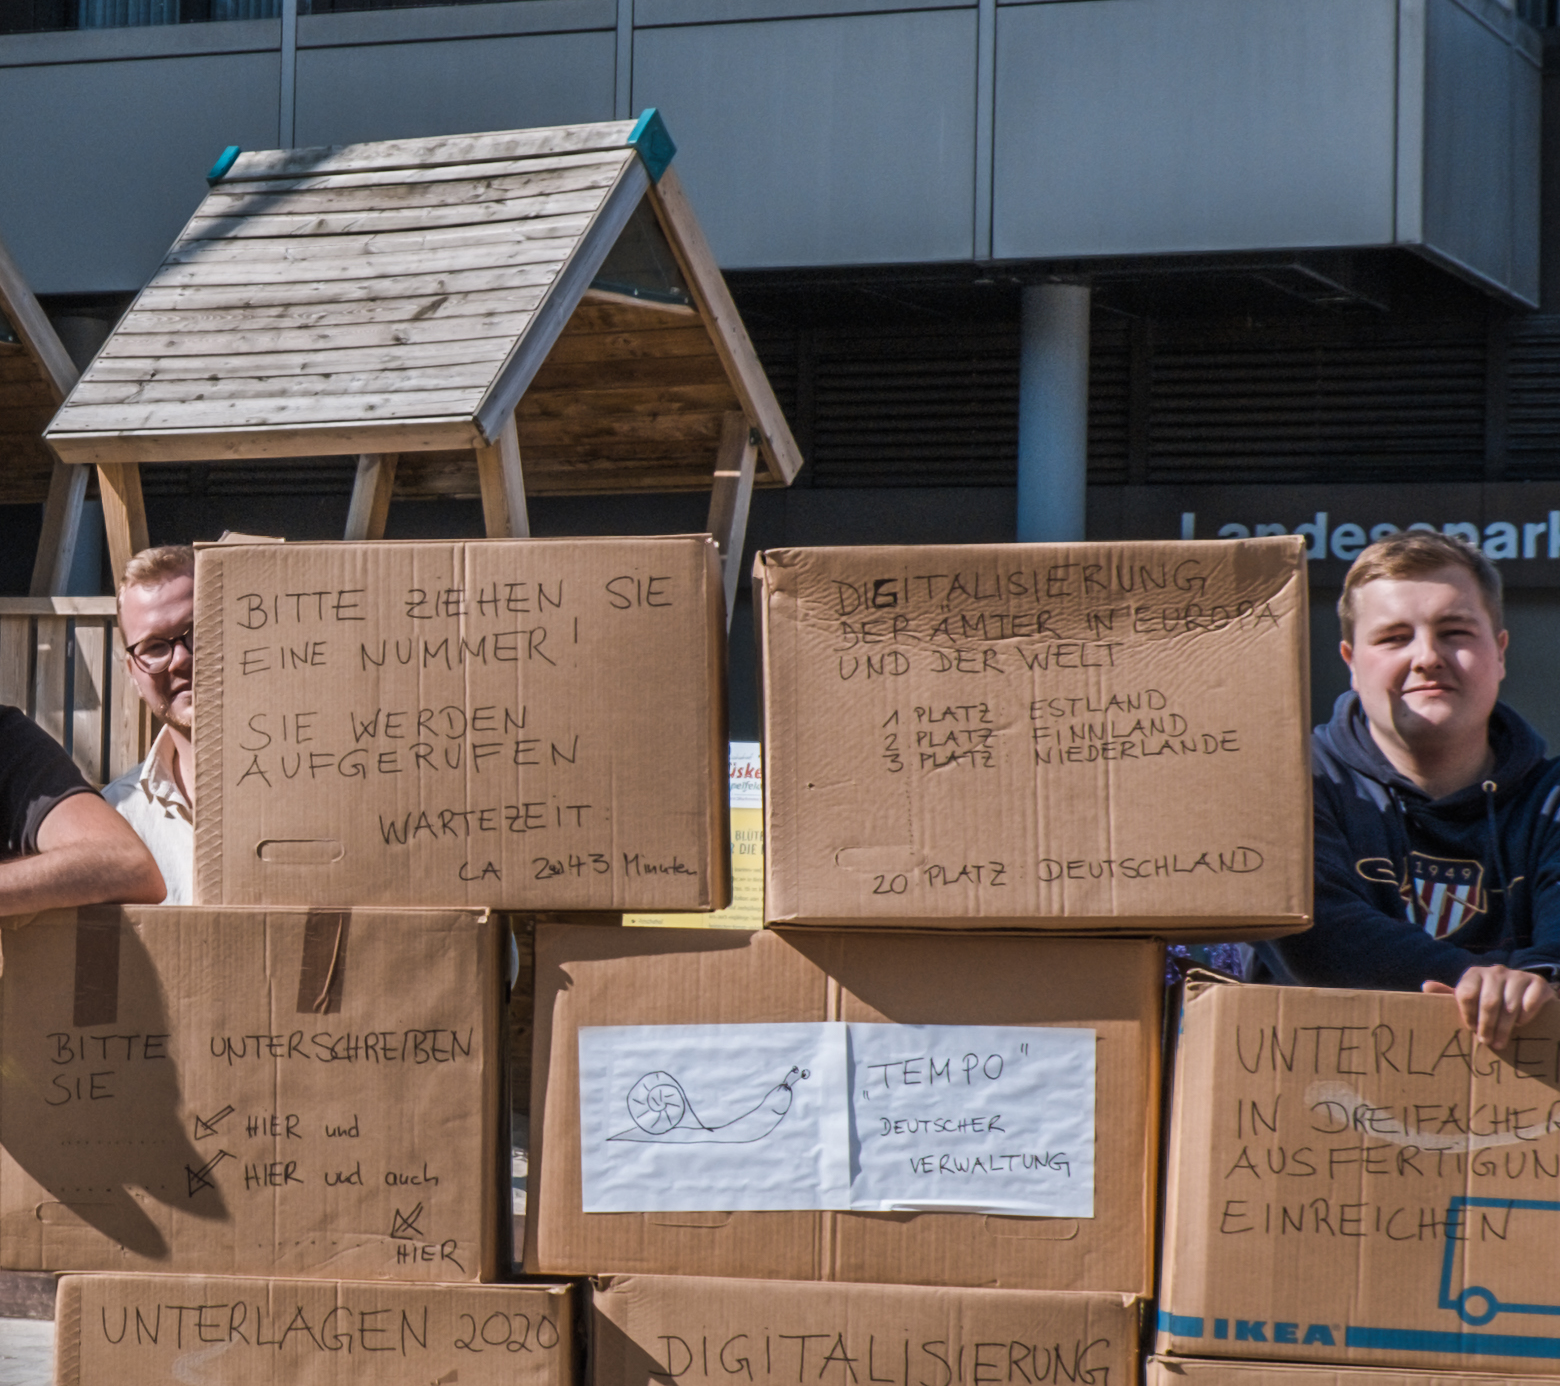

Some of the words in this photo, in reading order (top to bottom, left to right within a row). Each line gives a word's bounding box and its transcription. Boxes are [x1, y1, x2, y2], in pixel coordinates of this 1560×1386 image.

[236, 588, 367, 631] BITTE
[404, 577, 564, 621] ZIEHEN
[604, 575, 674, 611] SIE
[831, 559, 1207, 616] DIGITALISIERUNG
[832, 614, 917, 652] DER
[929, 605, 1063, 642] ÄMTER
[1079, 608, 1116, 639] IN
[1132, 599, 1282, 635] EUROPA
[239, 641, 330, 676] EINE
[837, 650, 911, 682] UND
[929, 648, 1005, 674] DER
[1016, 641, 1125, 672] WELT
[1029, 689, 1168, 720] ESTLAND
[239, 711, 318, 752] SIE
[350, 705, 528, 745] WERDEN
[1031, 714, 1189, 744] FINNLAND
[236, 734, 580, 788] AUFGERUFEN
[1034, 729, 1241, 767] NIEDERLANDE
[622, 853, 698, 879] Minuten
[1038, 845, 1265, 882] DEUTSCHLAND
[1414, 861, 1472, 881] 1949
[45, 1031, 170, 1066] BITTE
[209, 1026, 474, 1068] UNTERSCHREIBEN
[44, 1071, 116, 1107] SIE
[244, 1114, 302, 1140] HIER
[324, 1114, 361, 1140] und
[878, 1113, 1007, 1138] DEUTSCHER
[1236, 1093, 1281, 1139] IN
[243, 1159, 304, 1188] HIER
[324, 1160, 364, 1188] und
[384, 1162, 440, 1188] auch
[909, 1152, 1072, 1179] VERWALTUNG
[1219, 1197, 1516, 1243] EINREICHEN
[395, 1238, 466, 1274] HIER
[100, 1300, 429, 1355] UNTERLAGEN
[453, 1312, 561, 1353] 2020
